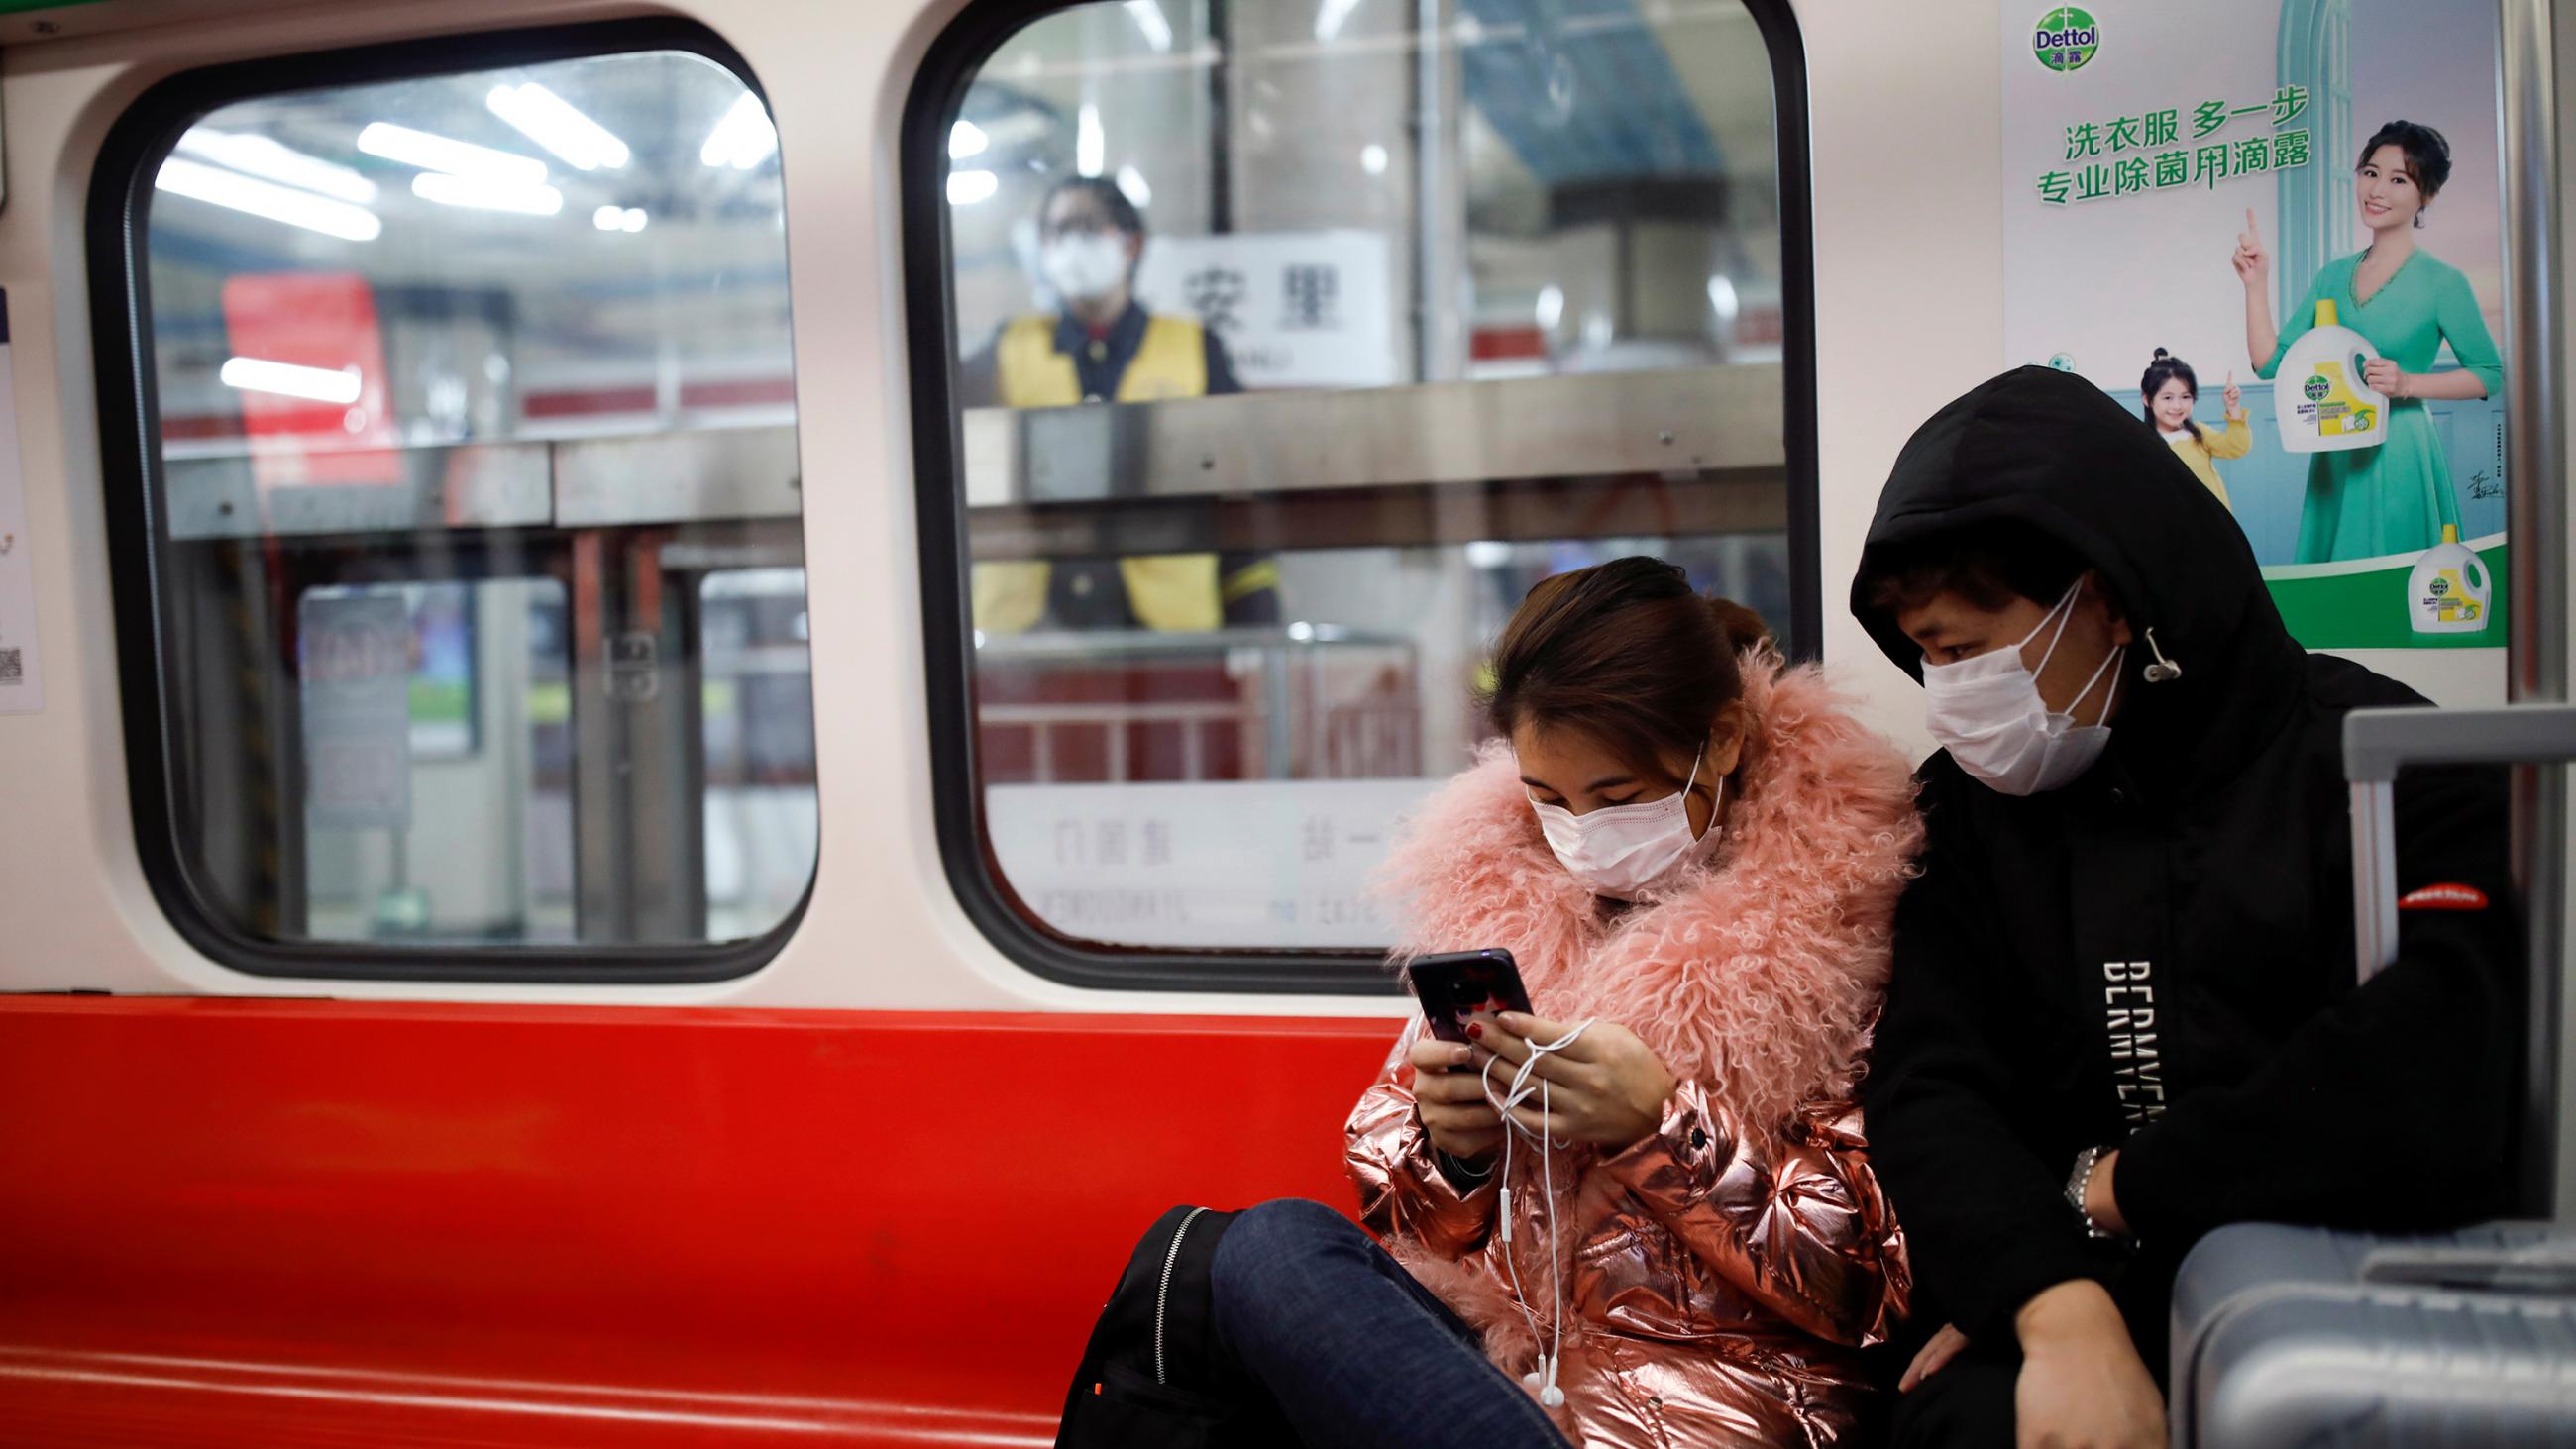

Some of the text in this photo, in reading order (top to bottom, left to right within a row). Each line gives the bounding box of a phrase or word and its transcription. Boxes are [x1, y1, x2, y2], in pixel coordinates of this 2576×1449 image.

[2036, 26, 2095, 49] Dettol
[2052, 51, 2082, 64] 滴露
[2065, 86, 2308, 161] 洗衣服 多一步
[2036, 129, 2309, 204] 专业除菌用滴露
[2304, 382, 2329, 393] Dettol
